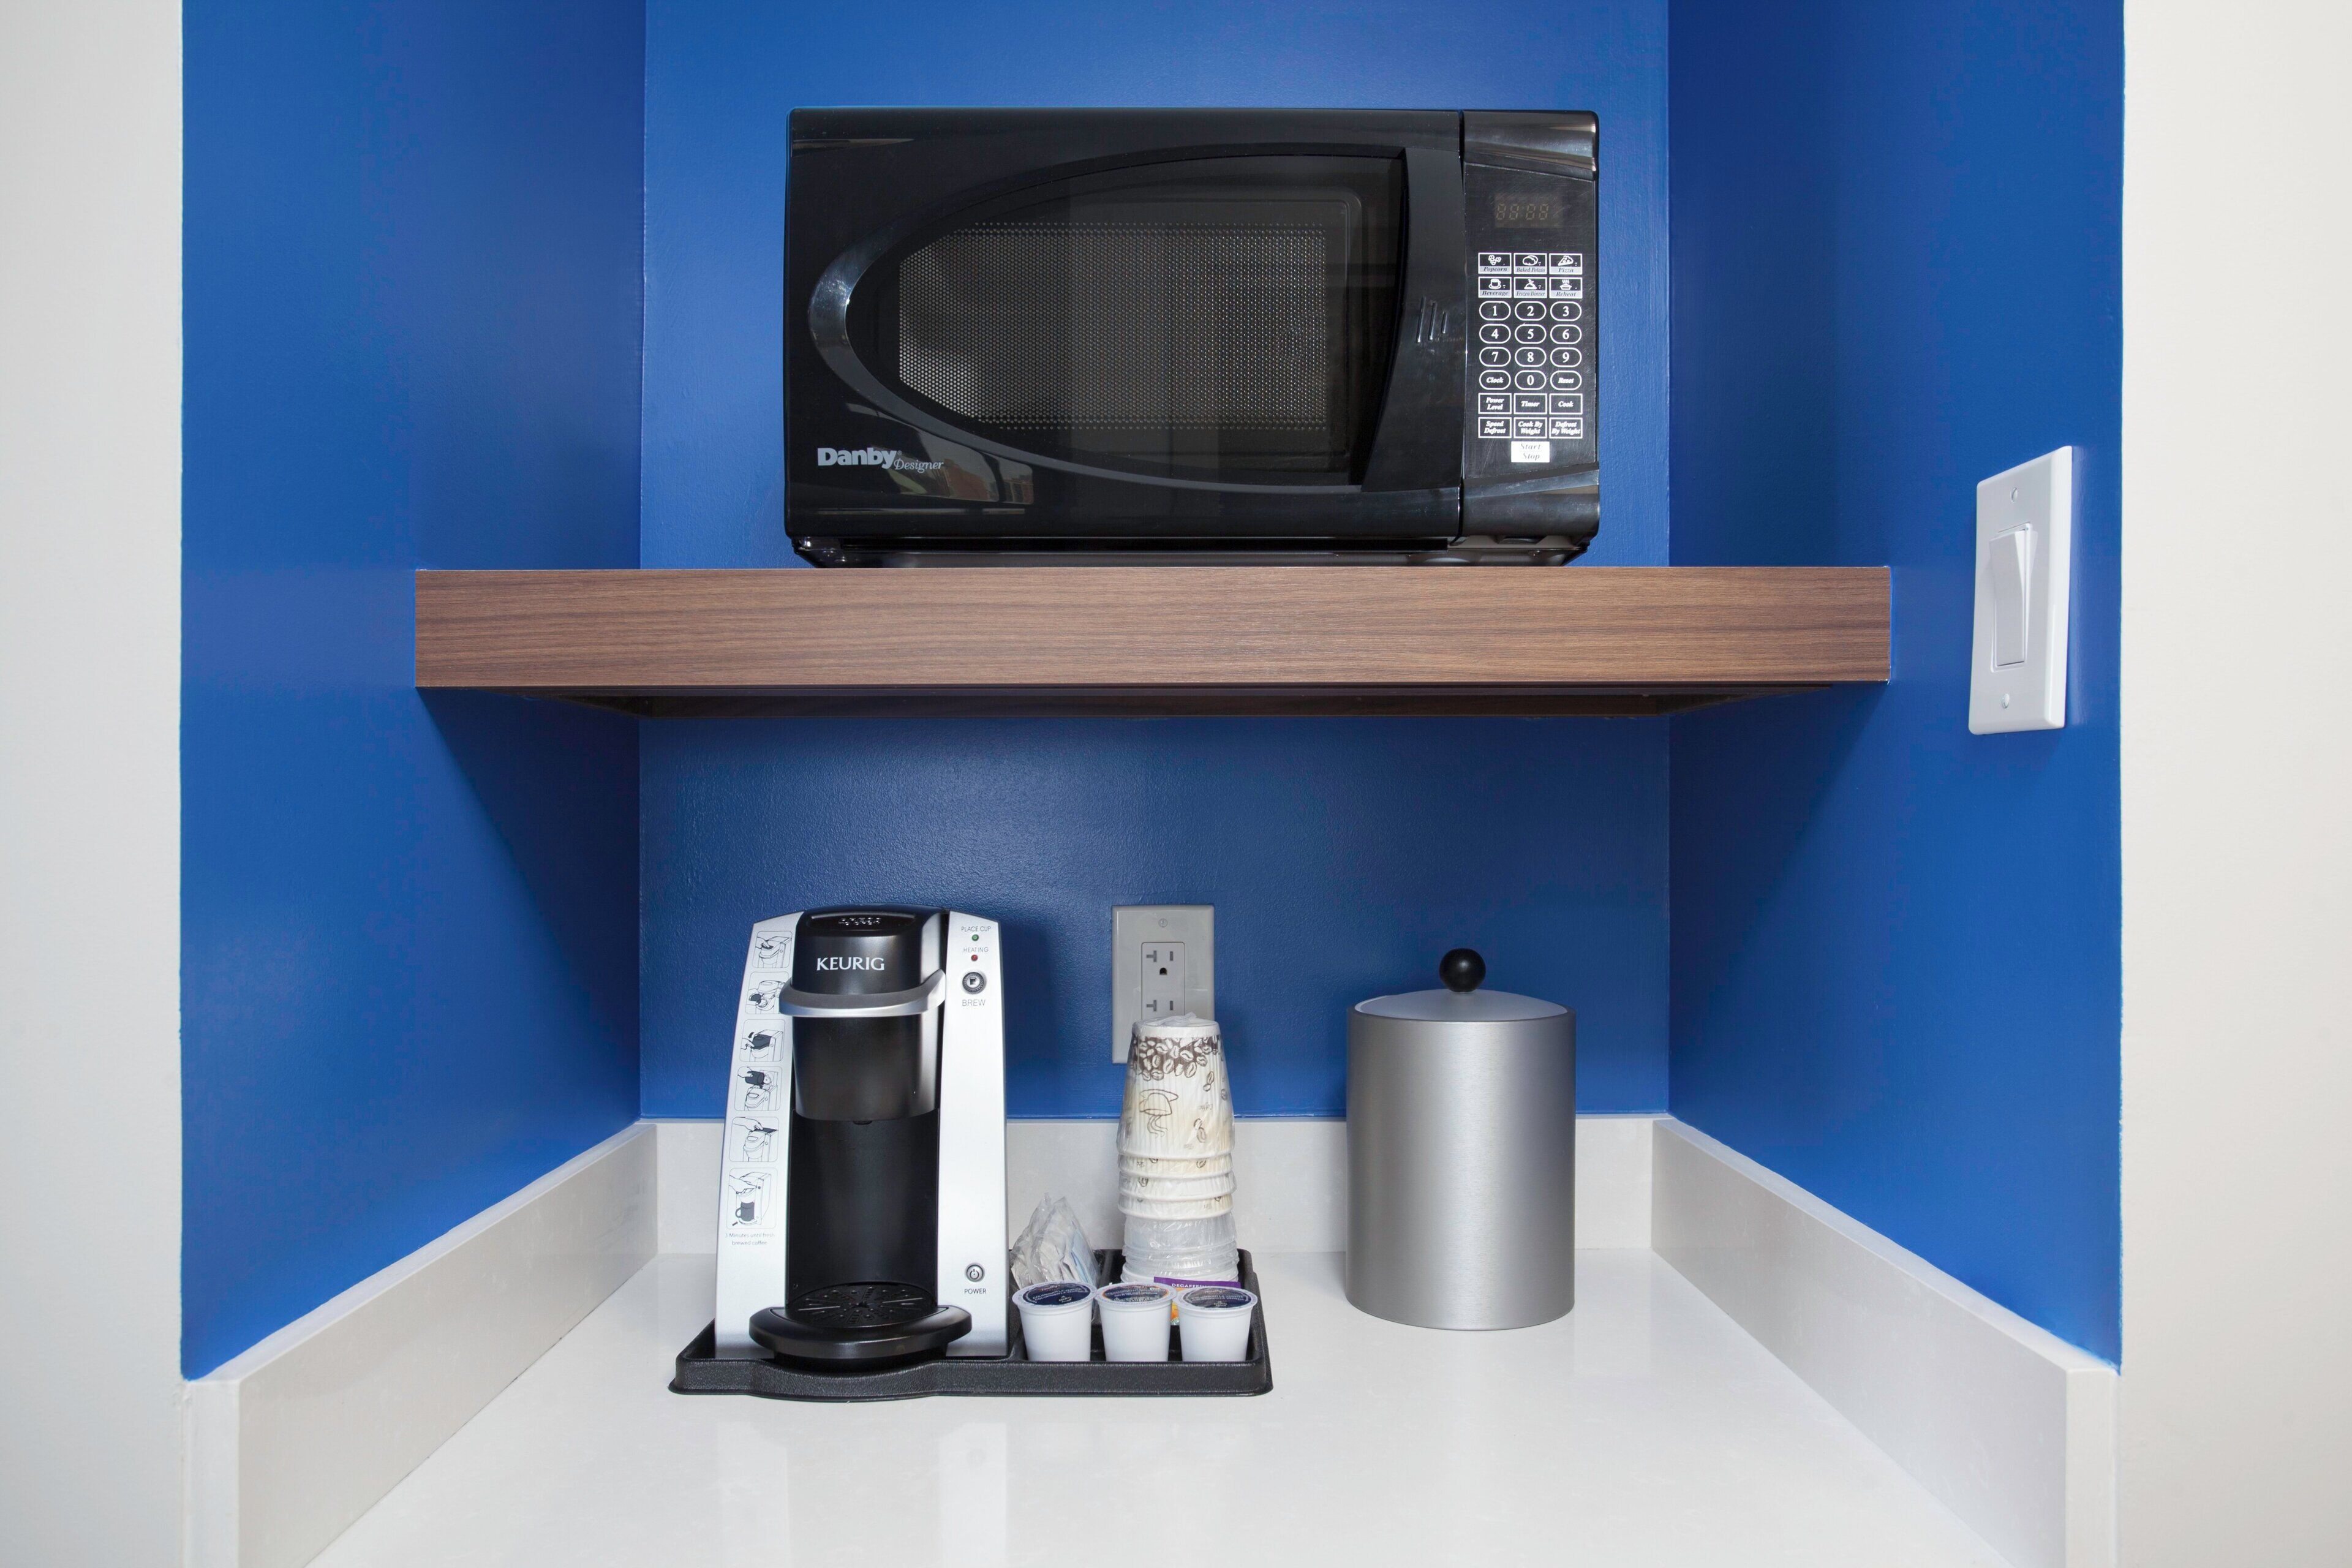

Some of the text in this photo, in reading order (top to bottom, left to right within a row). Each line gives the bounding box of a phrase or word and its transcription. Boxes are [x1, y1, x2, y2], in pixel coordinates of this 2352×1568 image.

[1492, 306, 1498, 316] 1
[1527, 306, 1534, 317] 2
[1562, 306, 1570, 317] 3
[1491, 328, 1499, 339] 4
[1527, 328, 1534, 339] 5
[1562, 328, 1570, 340] 6
[1491, 352, 1499, 363] 7
[1527, 352, 1534, 363] 8
[1562, 352, 1570, 363] 9
[1526, 375, 1534, 386] 0
[894, 458, 944, 473] Designer
[816, 957, 885, 971] KEURIG
